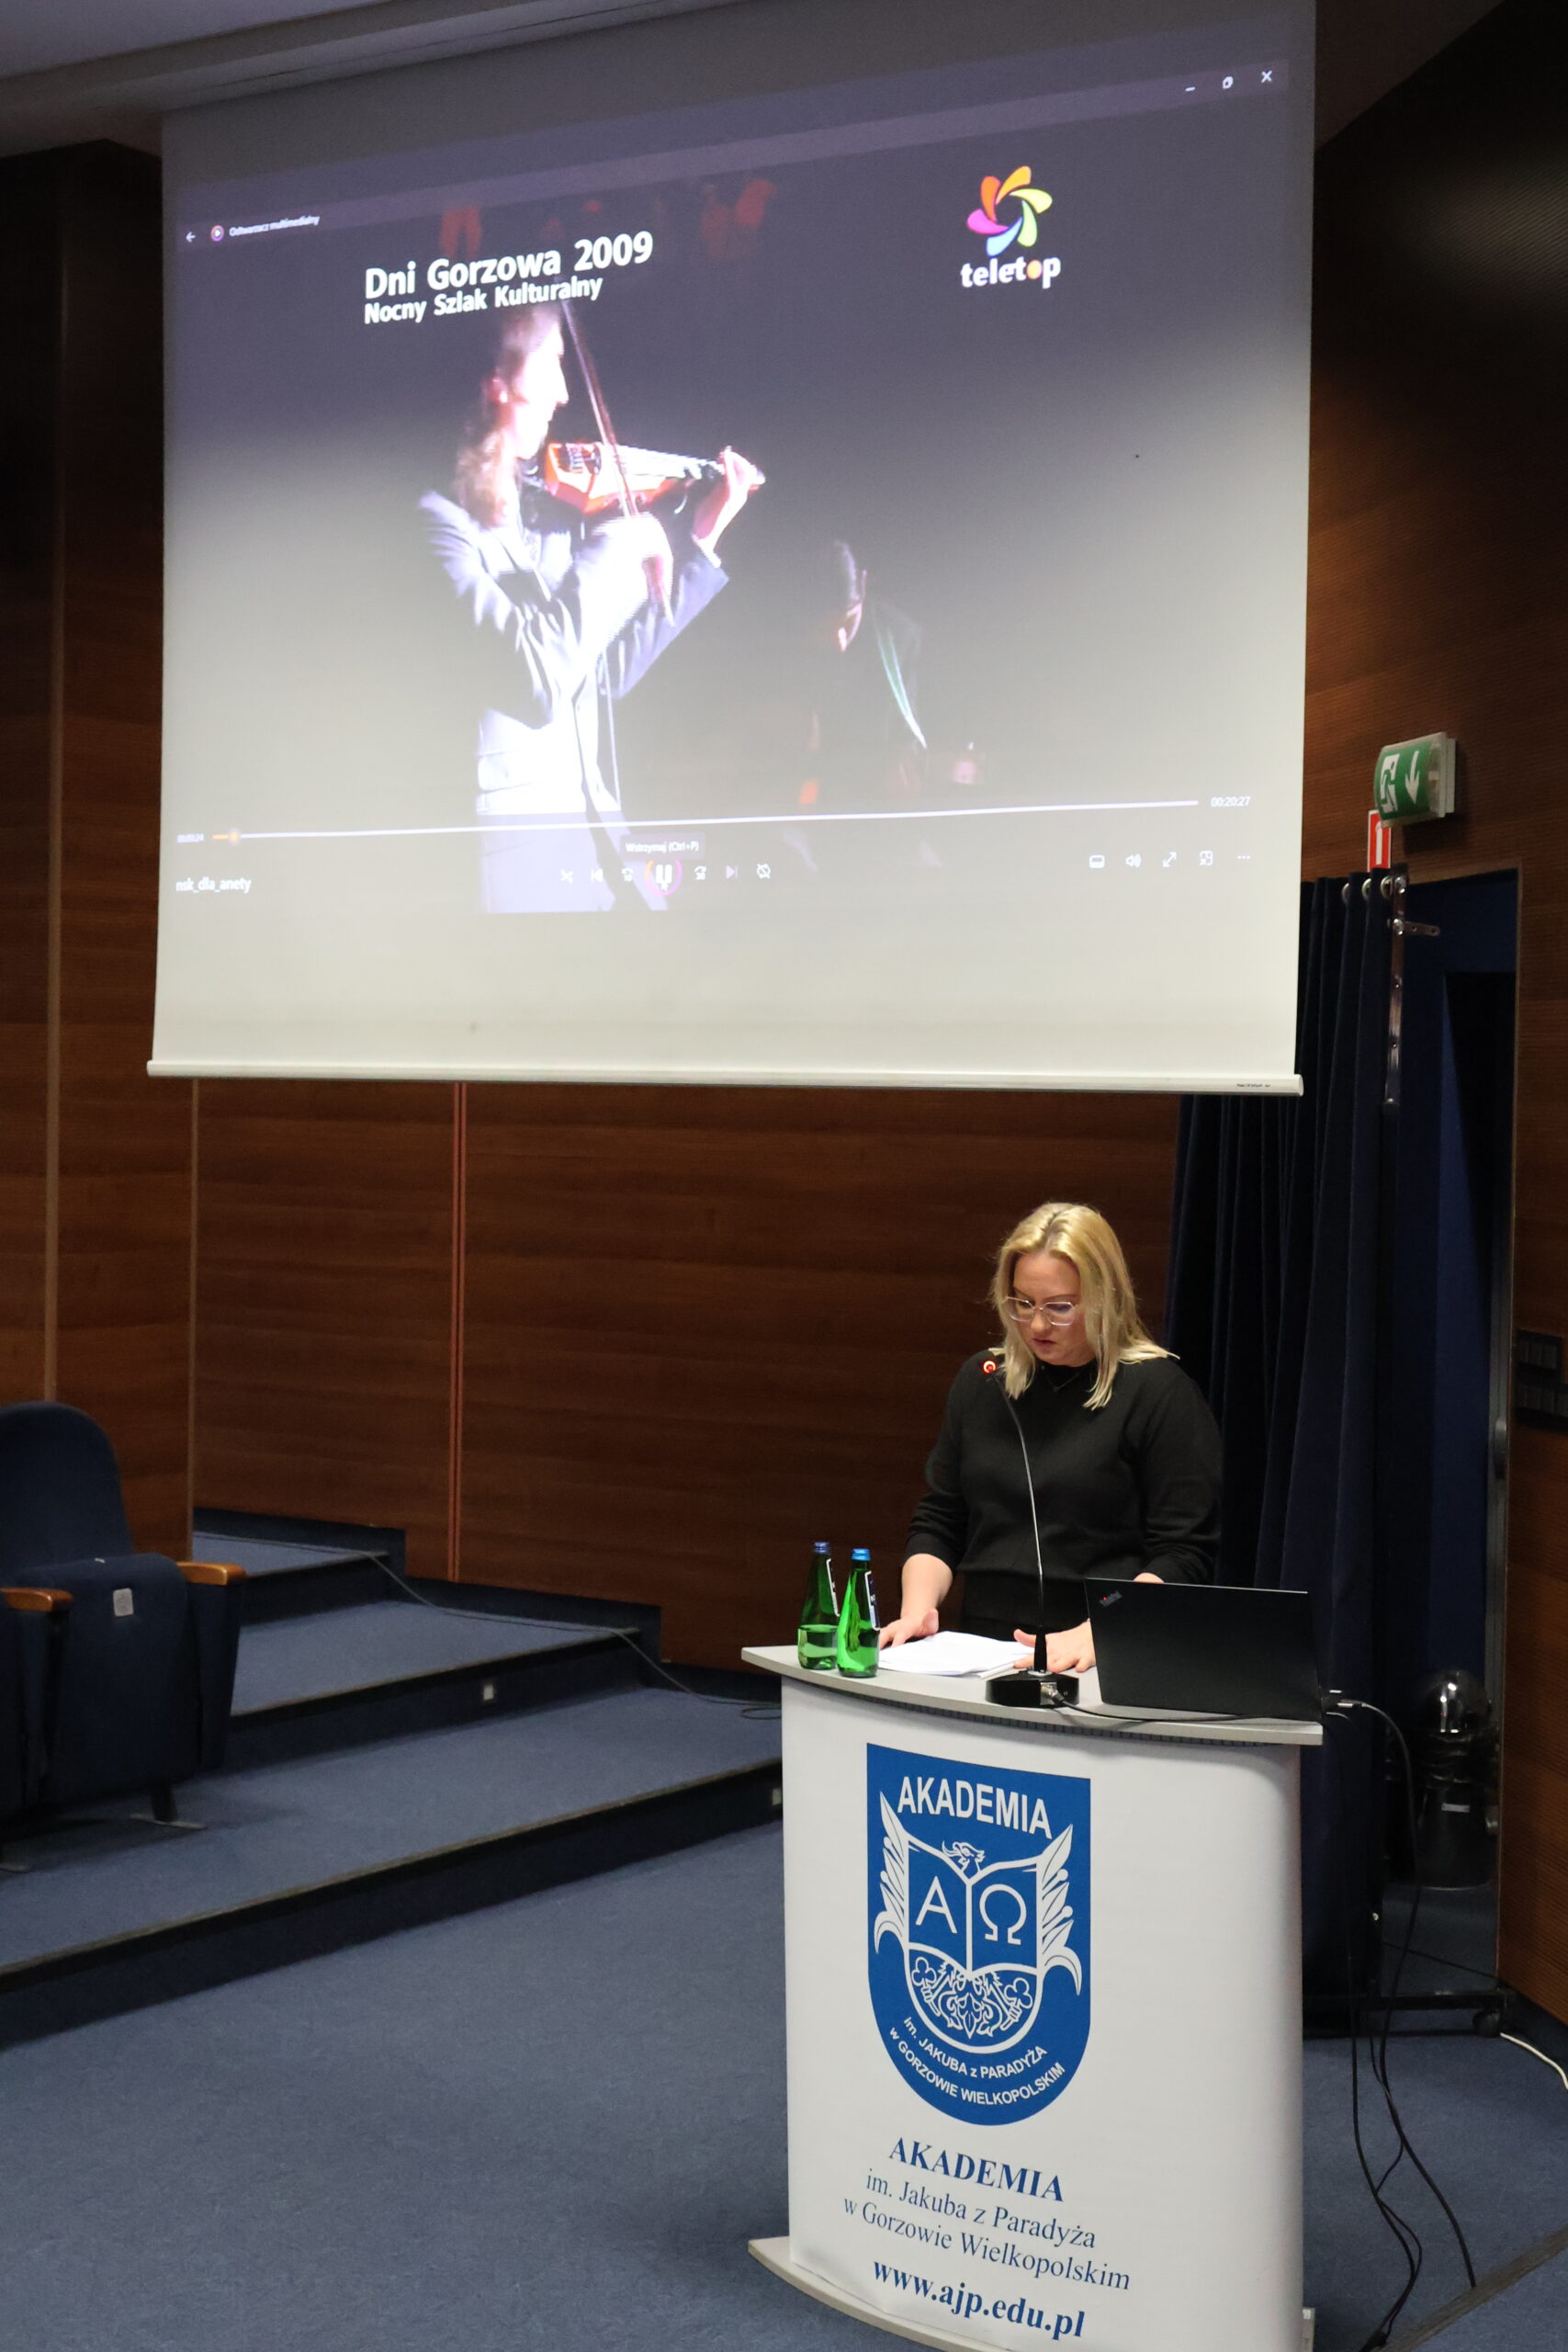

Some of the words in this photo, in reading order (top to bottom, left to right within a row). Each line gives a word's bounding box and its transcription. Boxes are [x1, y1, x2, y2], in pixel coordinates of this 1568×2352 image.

[365, 261, 416, 300] Dni
[426, 250, 561, 290] Gorzowa
[573, 231, 653, 272] 2009
[960, 256, 1061, 289] teletop
[364, 300, 426, 324] Nocny
[434, 288, 488, 316] Szlak
[494, 276, 604, 308] Kulturalny
[897, 1776, 1052, 1839] AKADEMIA
[915, 1875, 958, 1934] A
[897, 2040, 958, 2098] GORZOWIE
[961, 2062, 1066, 2106] WIELKOPOLSKIM
[919, 2036, 968, 2076] JAKUBA
[970, 2067, 977, 2077] z
[980, 2044, 1048, 2079] PARADYŻA
[888, 2137, 1064, 2203] AKADEMIA
[866, 2168, 892, 2198] im.
[898, 2181, 966, 2221] Jakuba
[973, 2208, 987, 2224] z
[992, 2206, 1096, 2249] Paradyża
[843, 2198, 858, 2215] w
[862, 2201, 953, 2250] Gorzowie
[961, 2232, 1131, 2290] Wielkopolskim
[874, 2261, 1086, 2341] www.ajp.edu.pl
